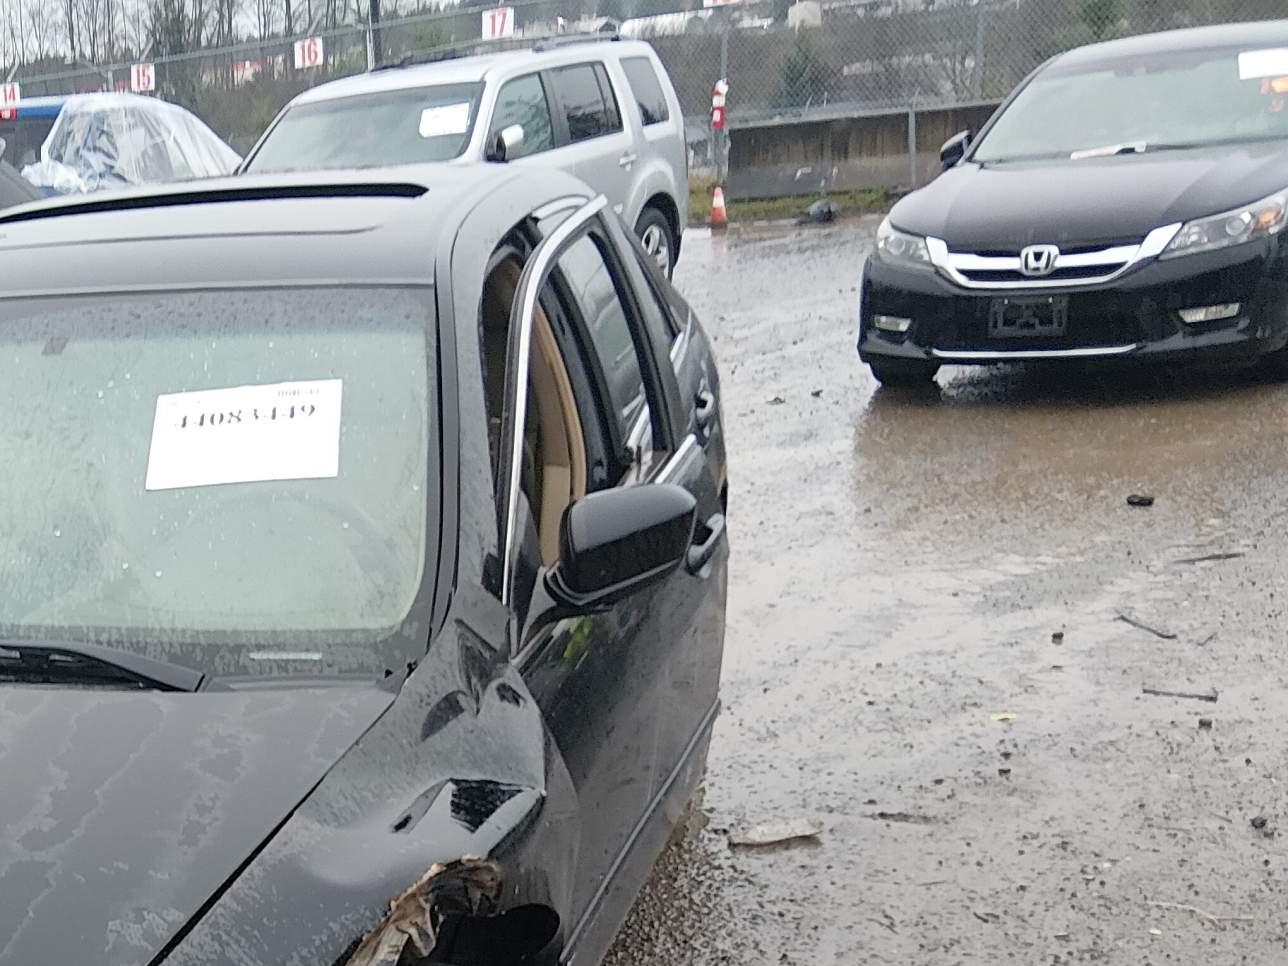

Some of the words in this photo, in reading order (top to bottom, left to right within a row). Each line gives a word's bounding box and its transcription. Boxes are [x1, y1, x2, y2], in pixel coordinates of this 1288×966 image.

[489, 9, 507, 37] 17
[301, 38, 318, 66] 16
[136, 64, 151, 89] 15
